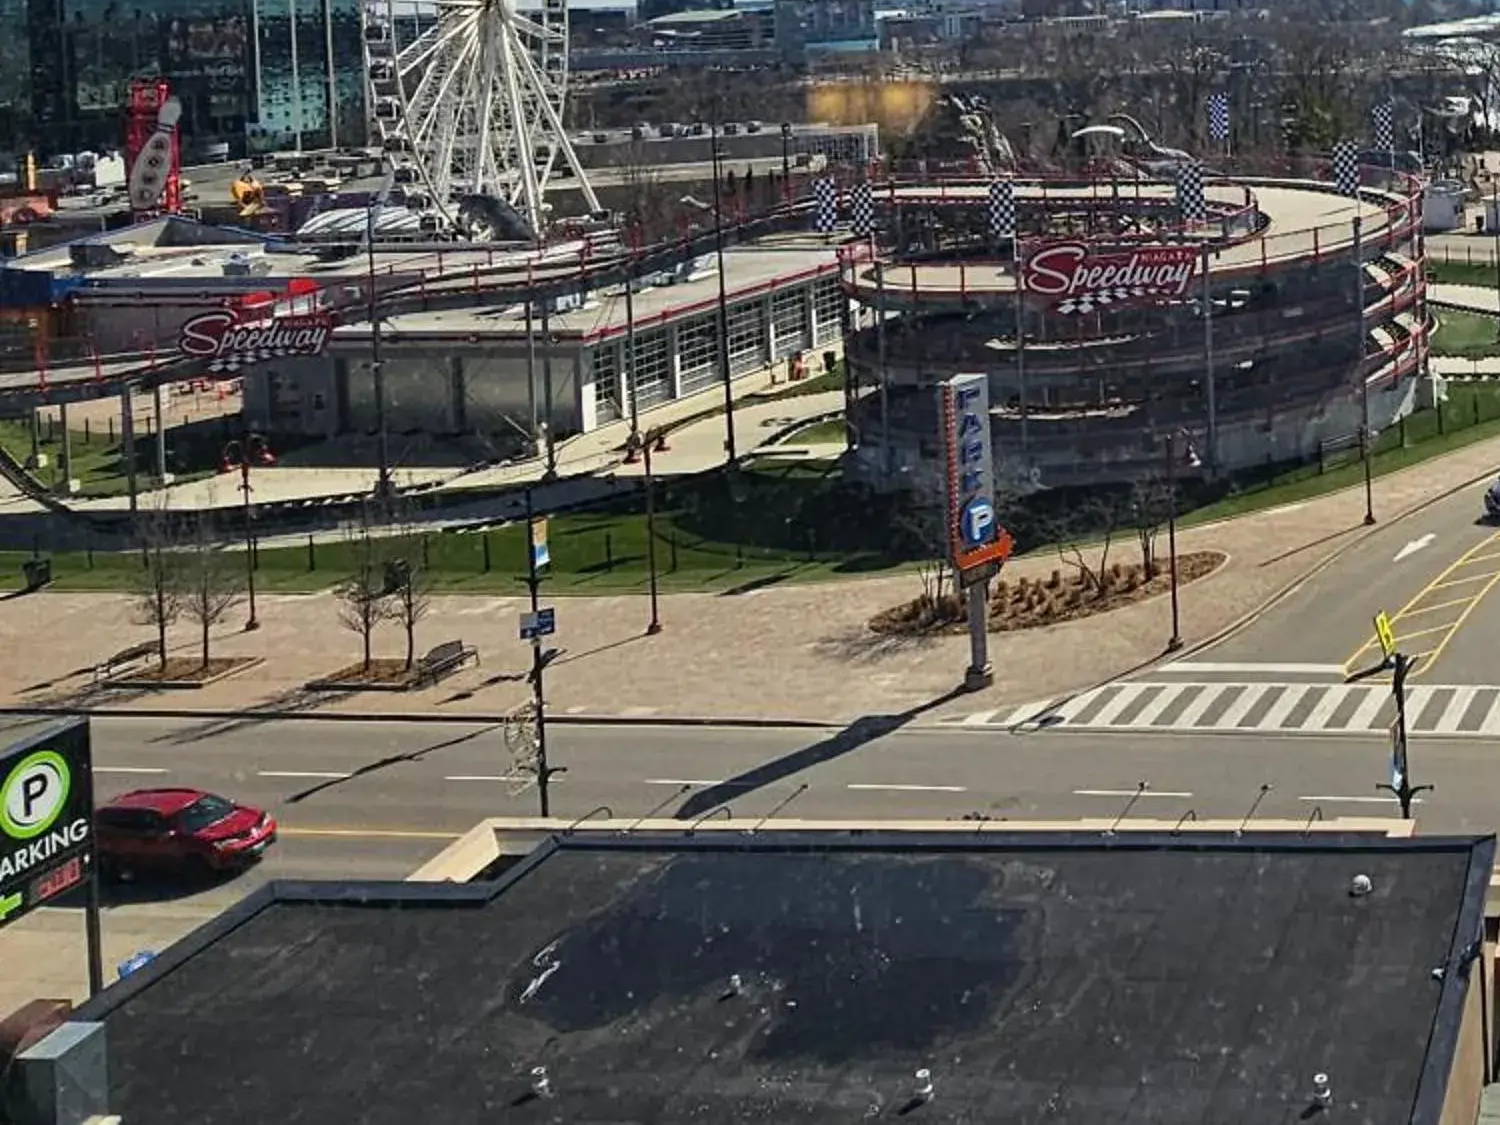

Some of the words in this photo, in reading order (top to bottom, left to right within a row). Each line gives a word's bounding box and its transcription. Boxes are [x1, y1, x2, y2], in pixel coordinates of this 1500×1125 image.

[1027, 246, 1193, 295] Speedway
[181, 314, 327, 356] Speedway
[968, 503, 994, 541] P
[22, 772, 48, 818] P
